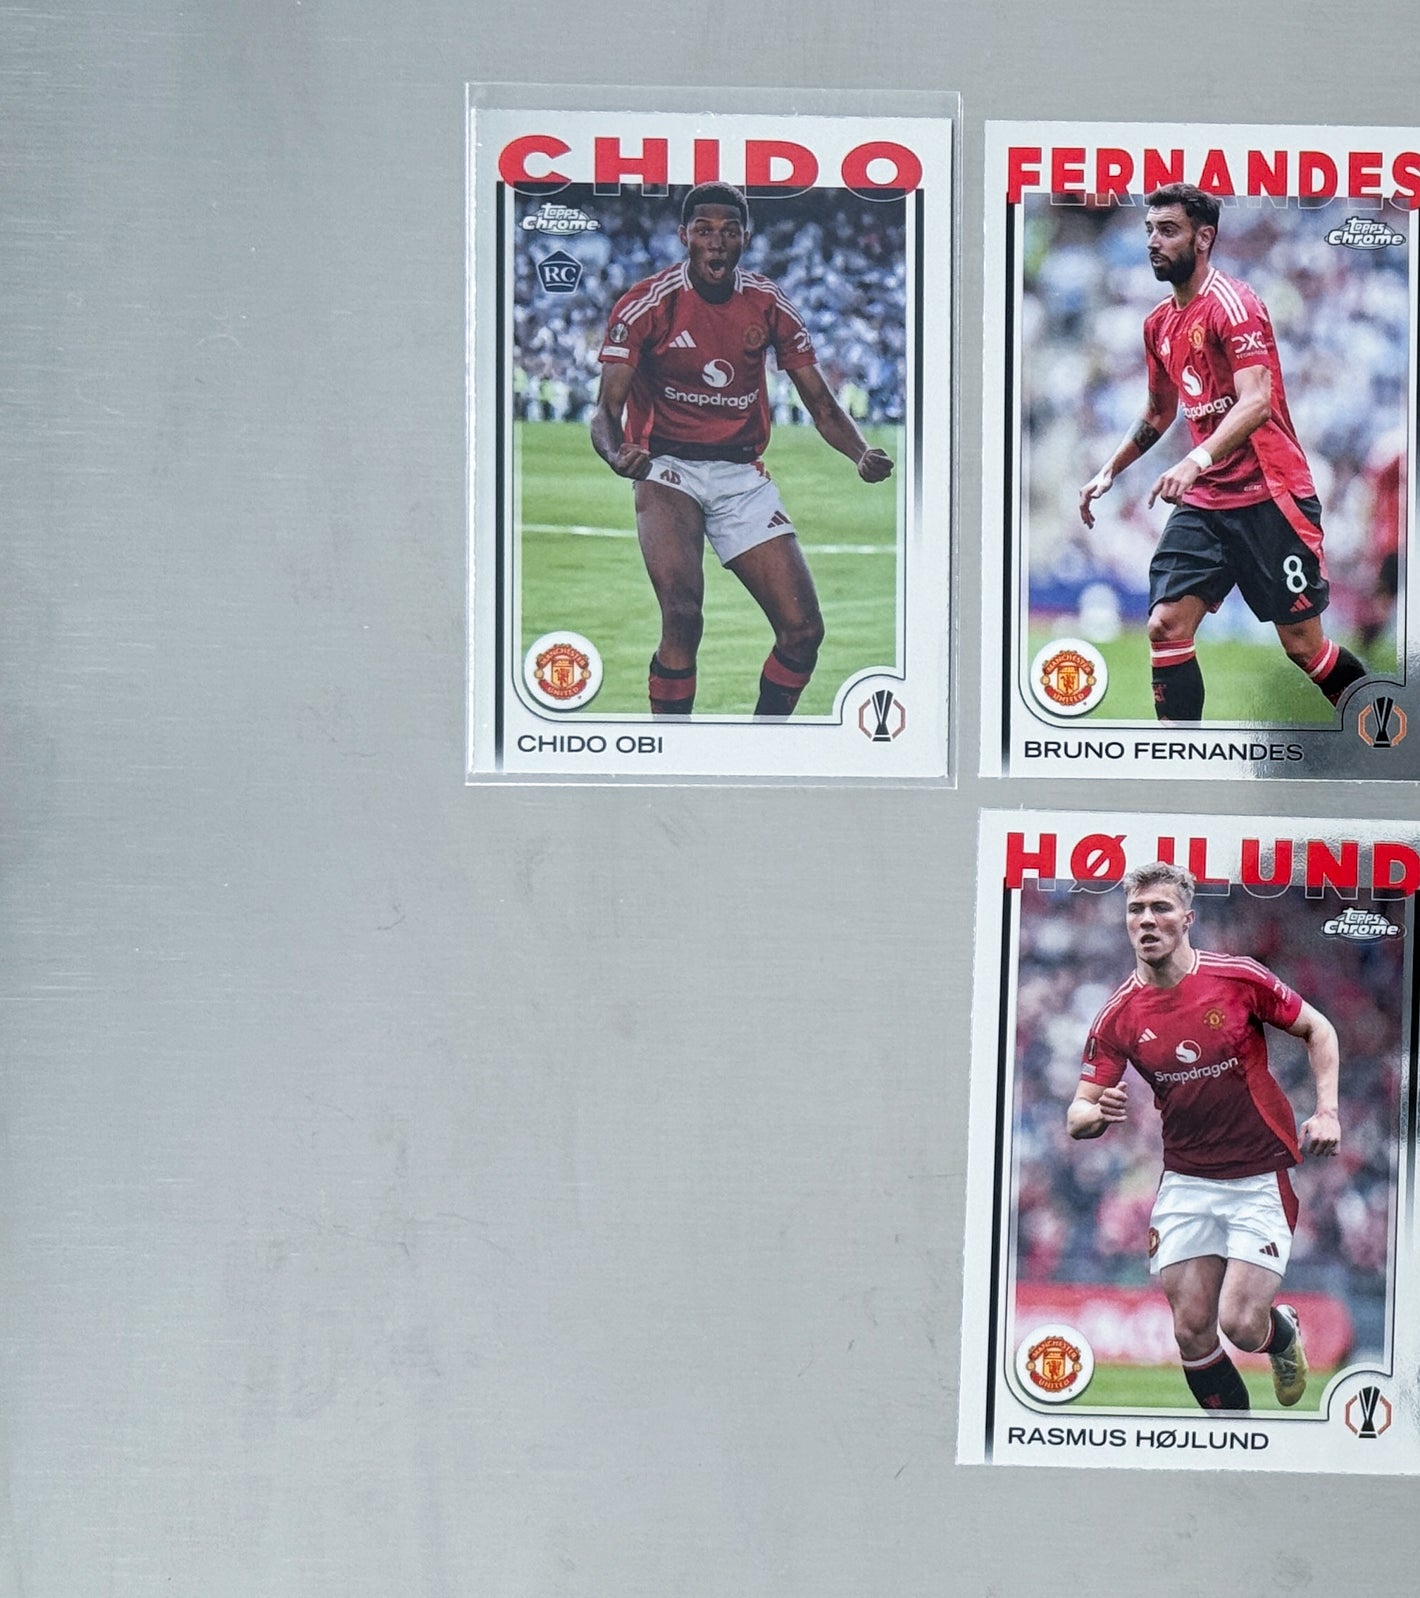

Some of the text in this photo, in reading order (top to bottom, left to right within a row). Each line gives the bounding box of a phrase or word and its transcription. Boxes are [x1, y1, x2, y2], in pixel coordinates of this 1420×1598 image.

[498, 135, 923, 202] CHIDO
[522, 216, 599, 231] Chrome
[1328, 230, 1404, 245] Chrome
[543, 266, 577, 282] RC
[664, 386, 759, 410] Snapdrago
[1283, 555, 1308, 593] 8
[517, 734, 663, 753] CHIDO OBI
[1024, 740, 1304, 762] BRUNO FERNANDES
[1323, 920, 1399, 935] Chrome
[1154, 1057, 1239, 1085] Snapdragon
[1007, 1426, 1270, 1450] RASMUS HØJLUND
